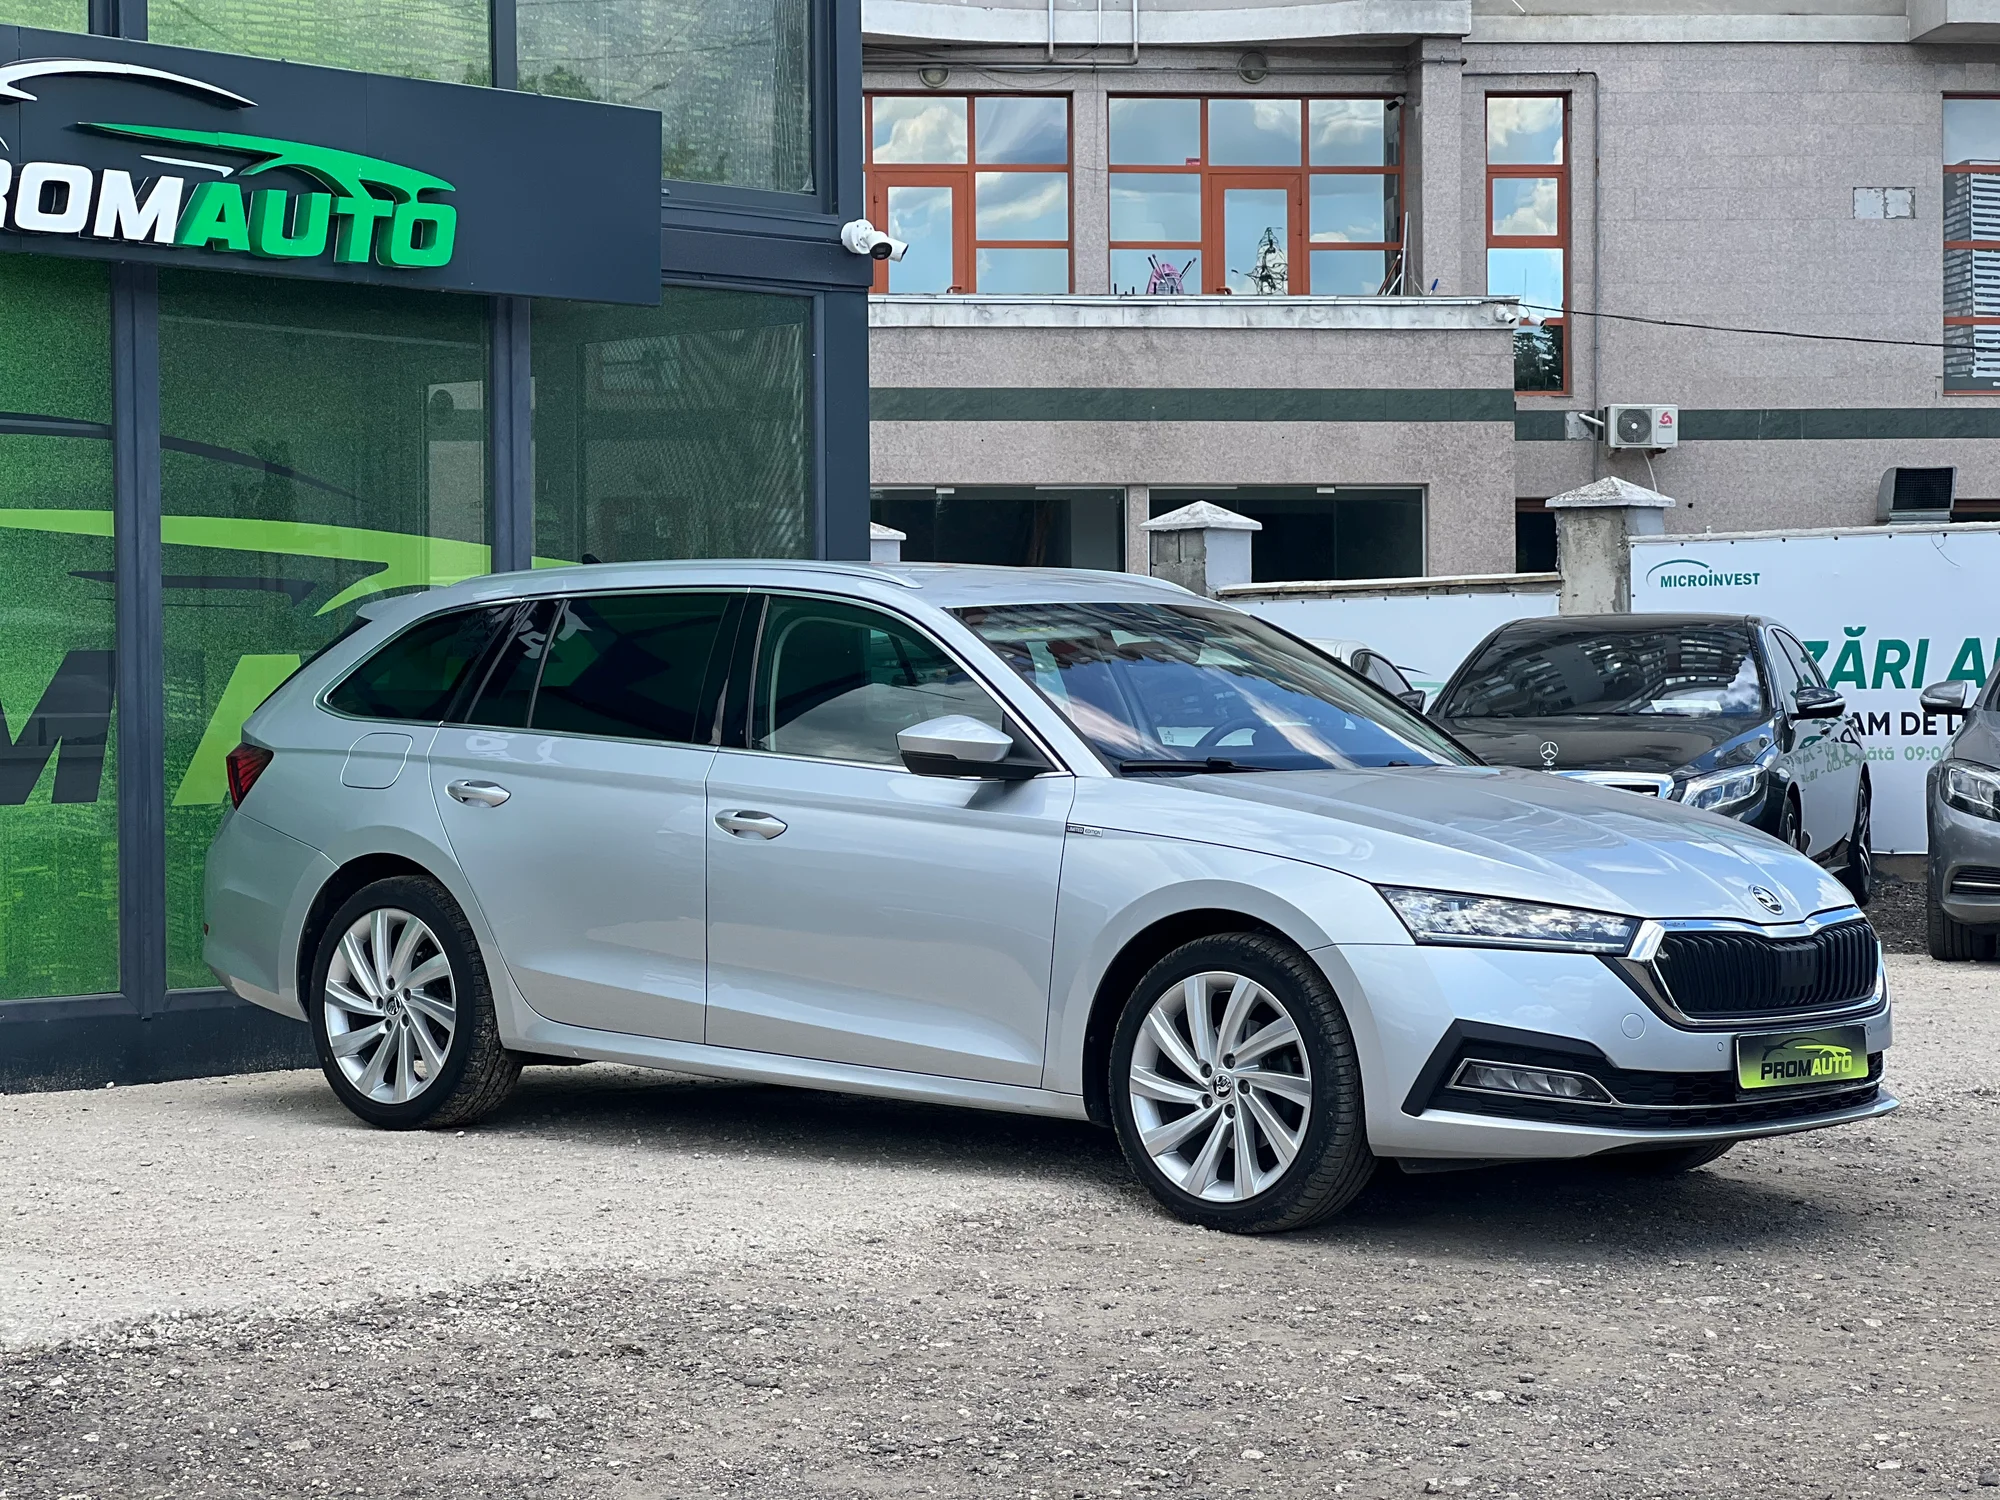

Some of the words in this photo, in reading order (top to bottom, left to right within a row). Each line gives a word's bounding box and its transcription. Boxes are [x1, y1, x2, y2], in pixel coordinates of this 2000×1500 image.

[0, 158, 457, 269] OMAUTO
[1901, 711, 1937, 735] DE
[1760, 1055, 1853, 1081] PROMAUTO
